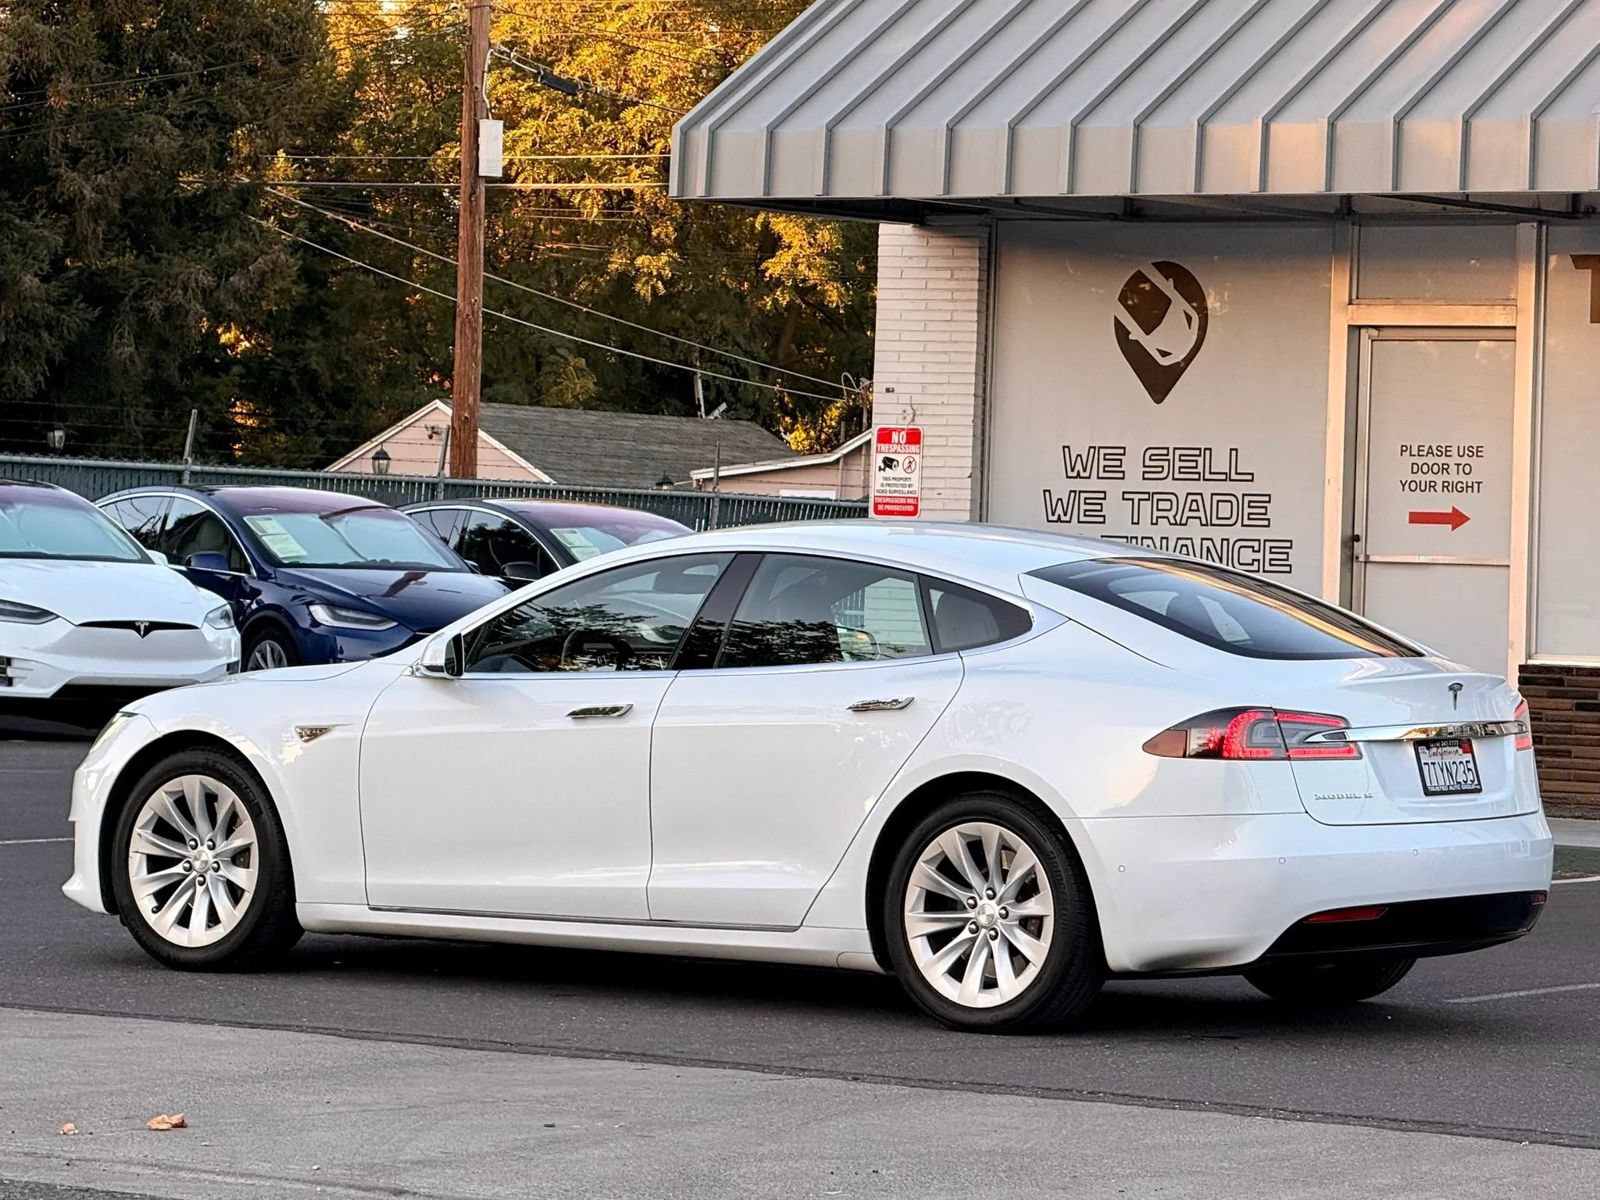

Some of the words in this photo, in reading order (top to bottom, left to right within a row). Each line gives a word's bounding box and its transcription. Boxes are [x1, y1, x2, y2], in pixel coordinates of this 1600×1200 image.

[891, 431, 907, 444] NO
[877, 443, 920, 453] TRESPASSING
[1400, 444, 1453, 457] PLEASE
[1457, 445, 1484, 458] USE
[1062, 445, 1126, 480] WE
[1142, 446, 1254, 482] SELL
[1410, 462, 1450, 475] DOOR
[1454, 463, 1472, 475] TO
[1400, 480, 1438, 493] YOUR
[1441, 480, 1483, 493] RIGHT
[1043, 489, 1106, 524] WE
[1122, 491, 1271, 527] TRADE
[1429, 747, 1459, 760] California
[1423, 760, 1475, 786] 7TYN235
